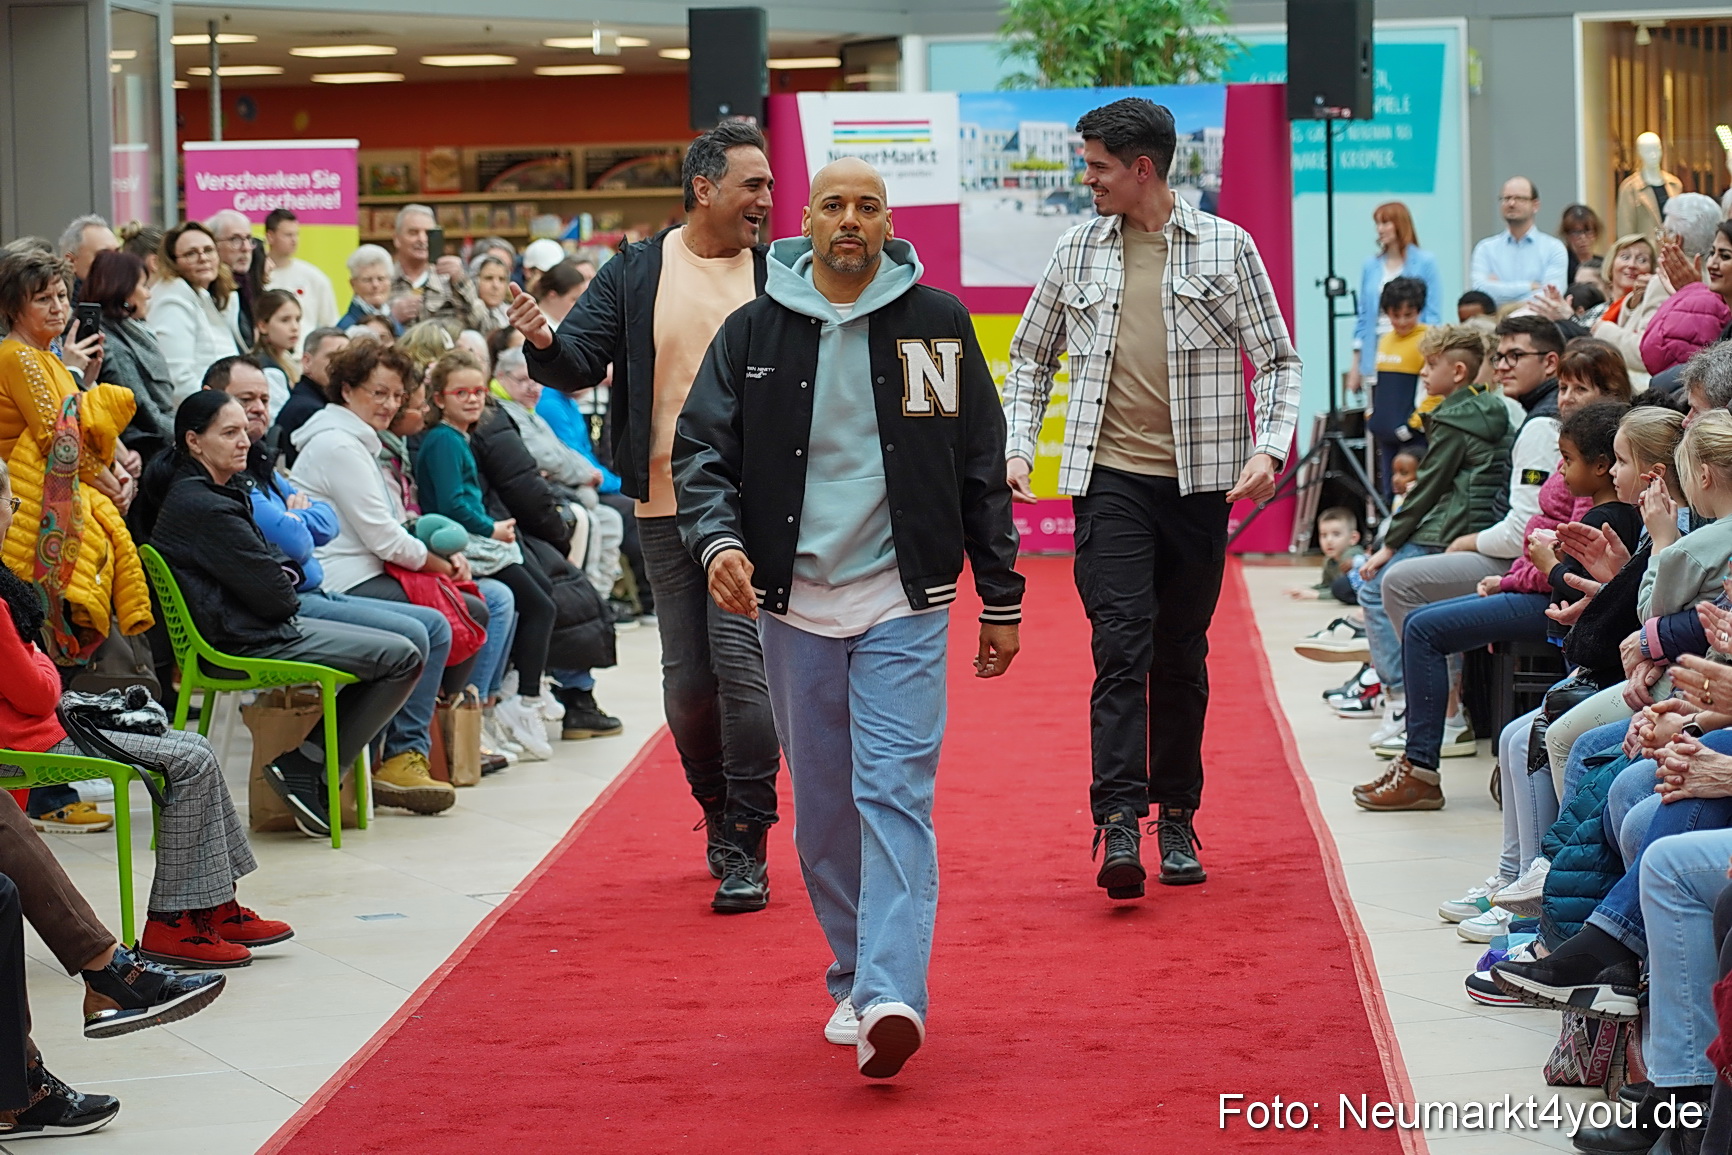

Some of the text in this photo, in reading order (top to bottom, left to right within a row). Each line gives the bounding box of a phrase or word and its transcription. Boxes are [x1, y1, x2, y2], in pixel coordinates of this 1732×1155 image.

[195, 169, 341, 191] Verschenken Sie
[233, 190, 342, 211] Gutscheine!
[896, 338, 964, 418] N
